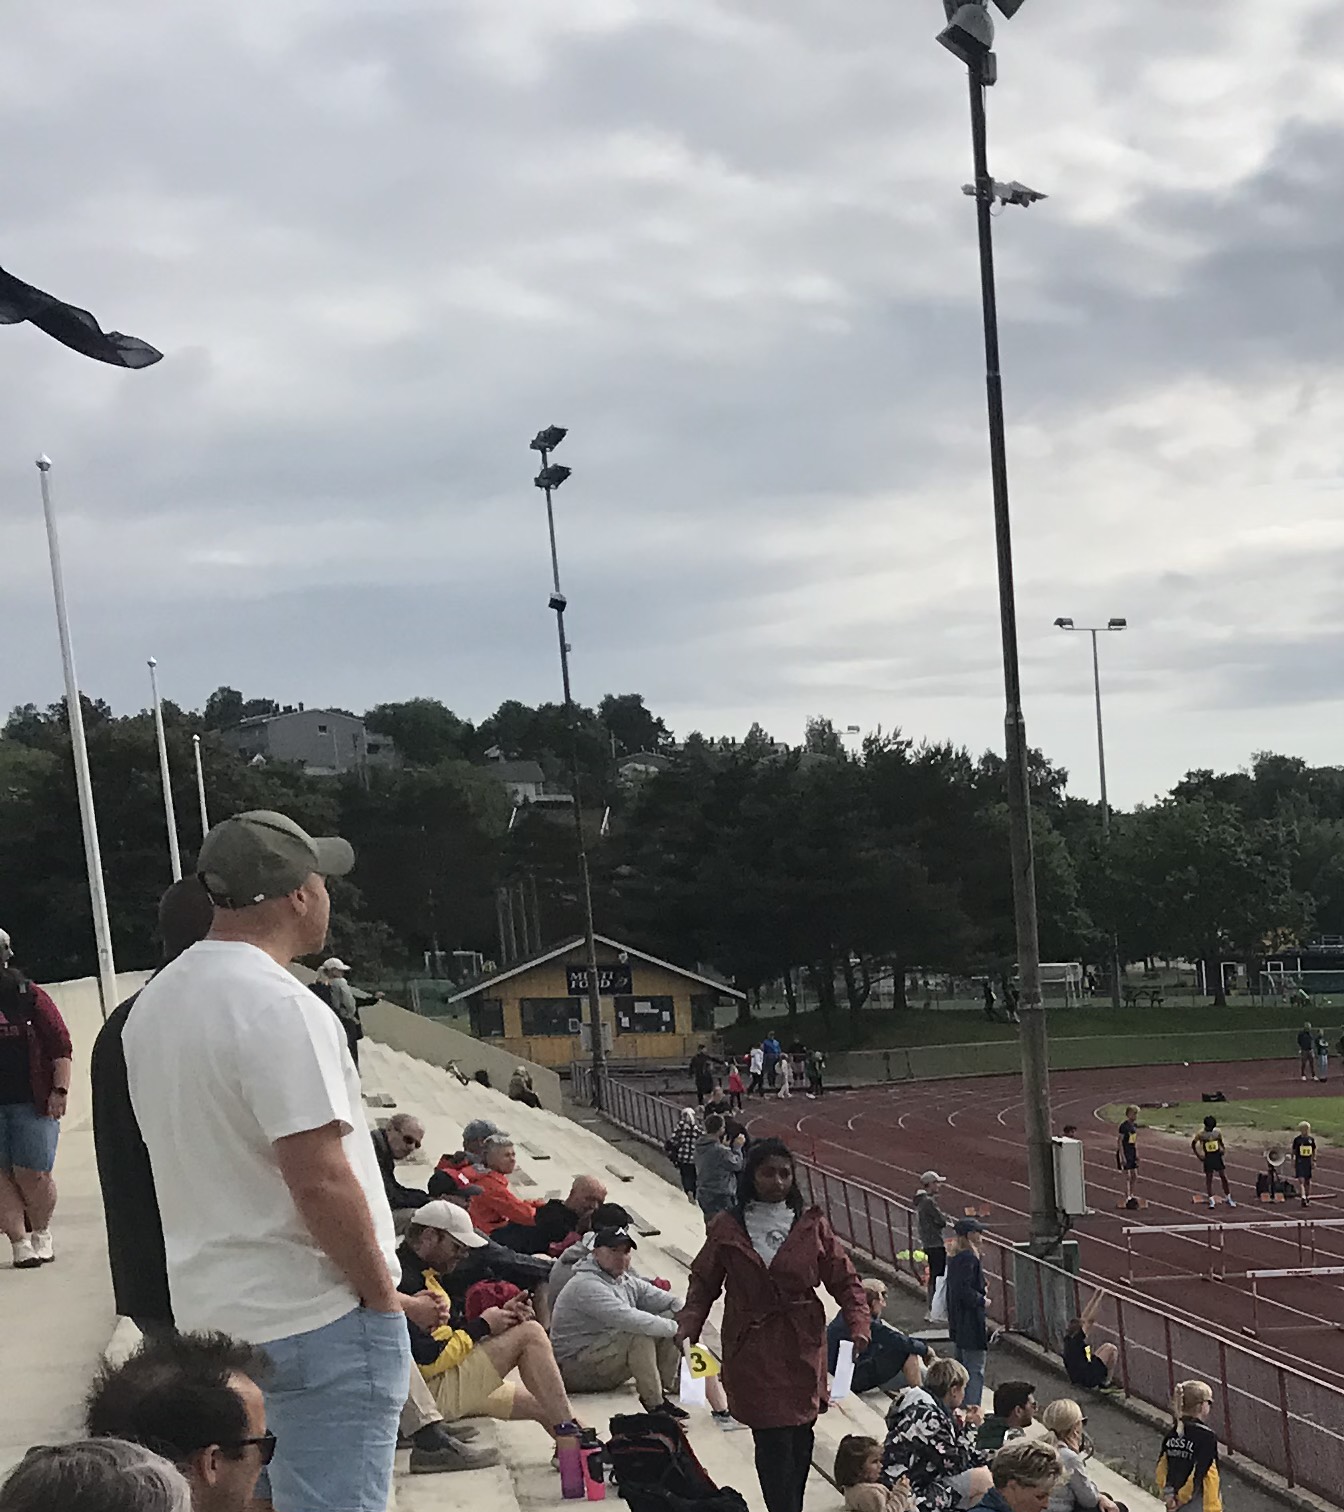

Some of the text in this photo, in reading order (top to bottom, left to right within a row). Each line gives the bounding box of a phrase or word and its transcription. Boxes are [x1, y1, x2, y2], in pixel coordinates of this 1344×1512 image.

[570, 971, 614, 980] MUTI
[570, 980, 611, 989] FOD
[690, 1352, 707, 1372] 3
